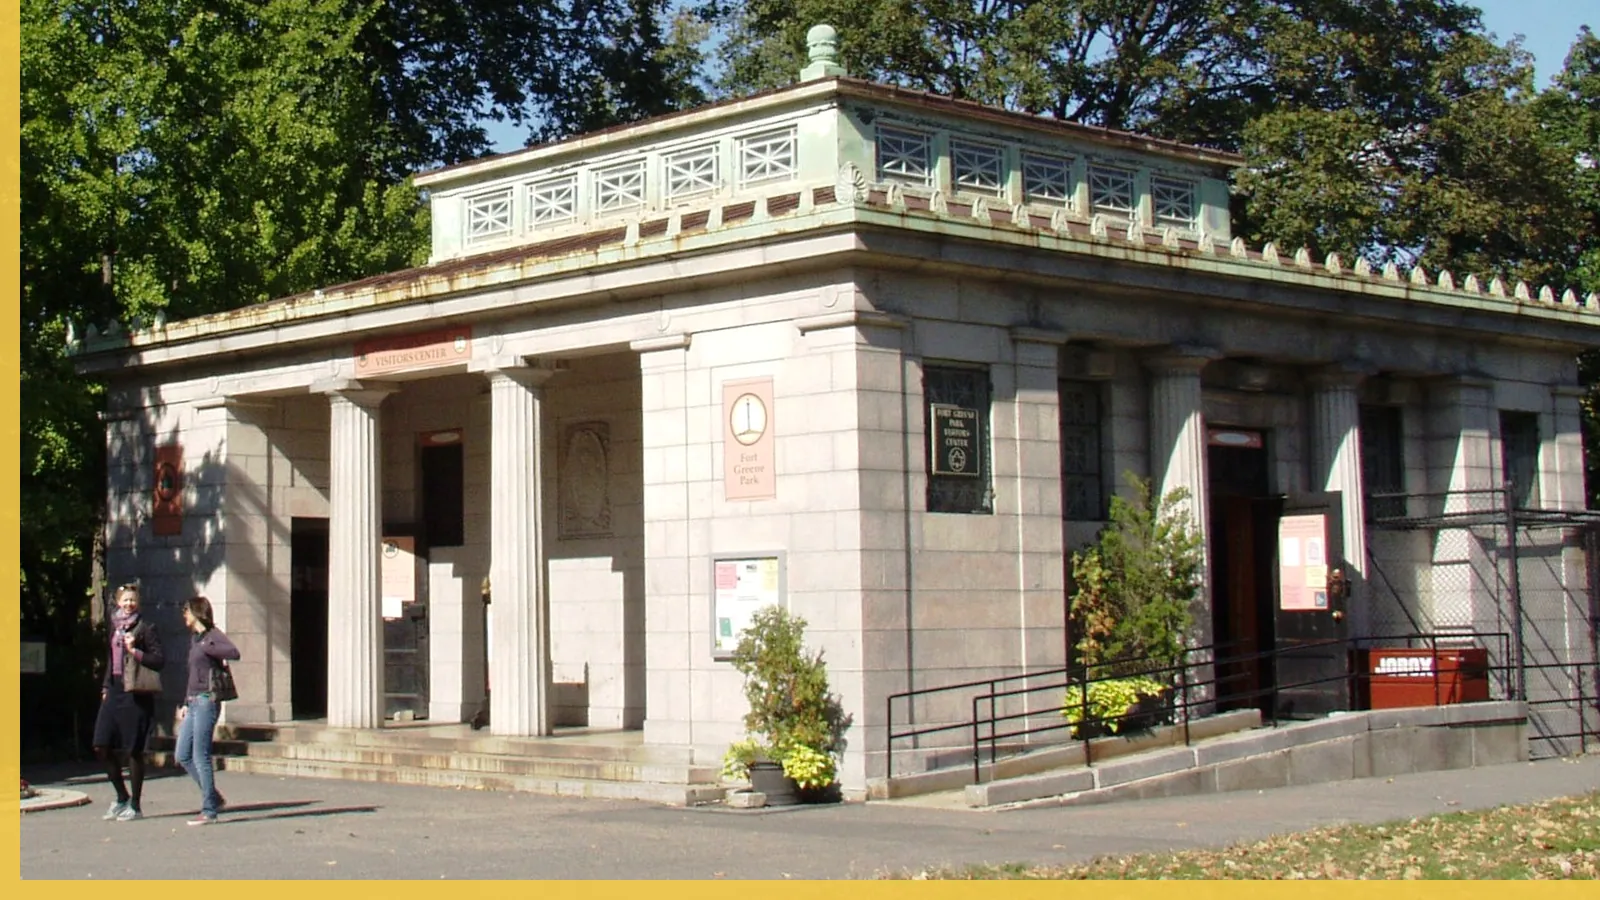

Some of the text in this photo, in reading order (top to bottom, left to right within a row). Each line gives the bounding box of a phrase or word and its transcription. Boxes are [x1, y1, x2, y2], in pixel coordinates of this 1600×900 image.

[375, 348, 448, 367] VISITORS CENTER
[949, 418, 965, 428] PARK
[945, 438, 969, 447] CENTER
[740, 452, 758, 463] Fort
[733, 464, 765, 475] Greene
[740, 475, 760, 486] Park
